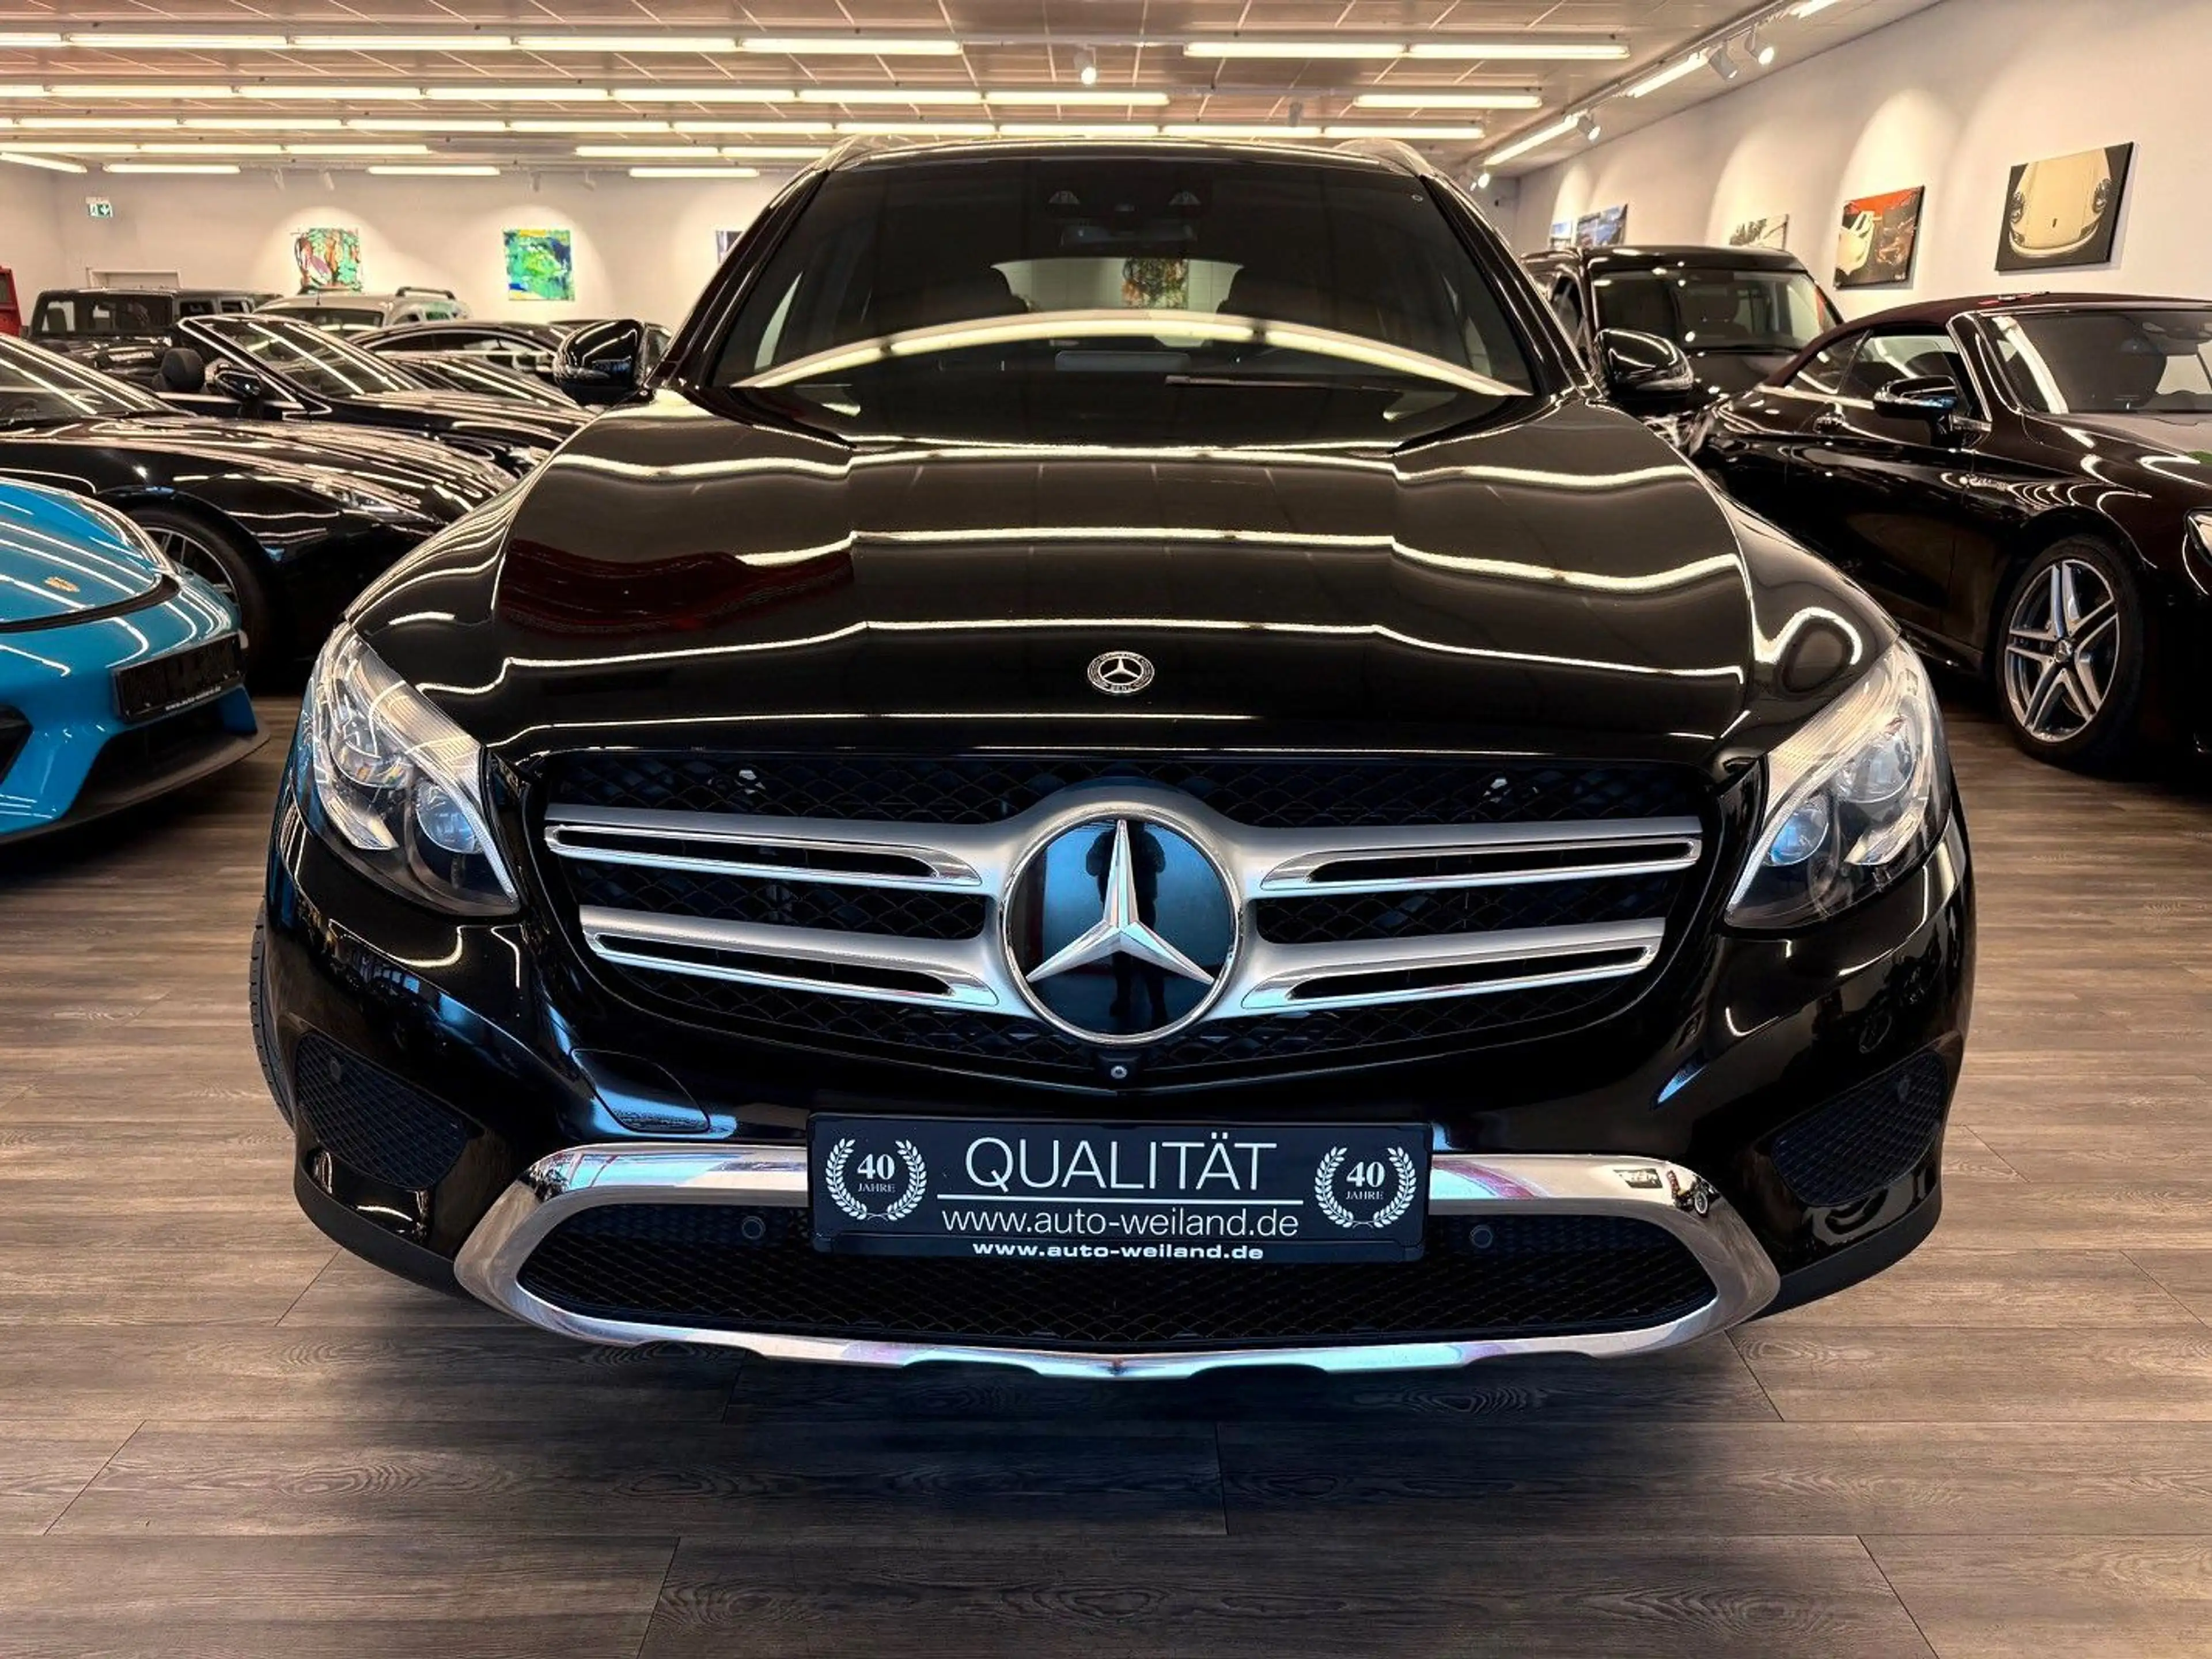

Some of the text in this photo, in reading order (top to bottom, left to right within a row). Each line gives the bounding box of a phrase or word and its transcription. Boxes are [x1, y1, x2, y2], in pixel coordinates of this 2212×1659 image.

[857, 1154, 895, 1180] 40
[965, 1132, 1277, 1194] QUALITÄT
[1346, 1162, 1385, 1187] 40
[858, 1183, 896, 1192] JAHRE
[1346, 1191, 1384, 1200] JAHRE
[942, 1207, 1299, 1237] www.auto-weiland.de
[972, 1243, 1263, 1260] www.auto-weiland.de
